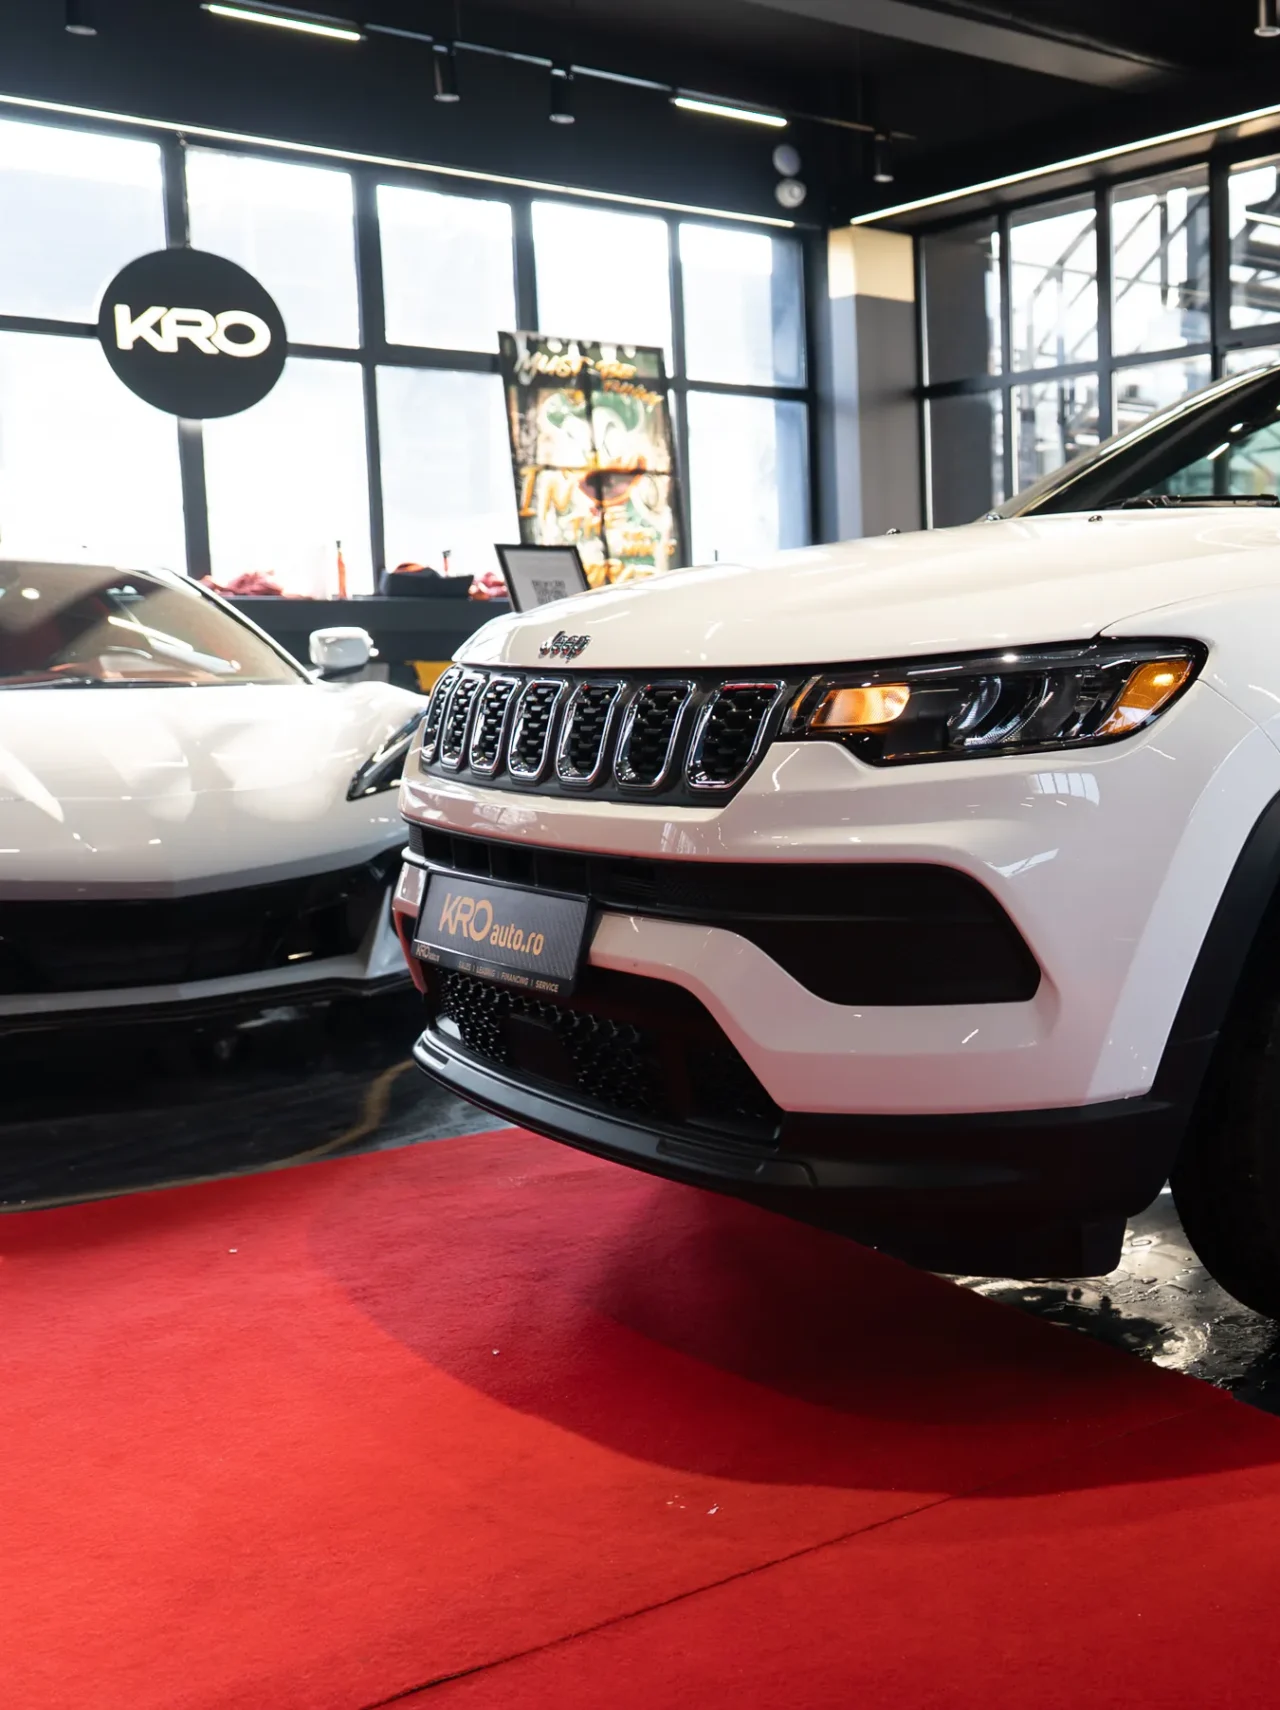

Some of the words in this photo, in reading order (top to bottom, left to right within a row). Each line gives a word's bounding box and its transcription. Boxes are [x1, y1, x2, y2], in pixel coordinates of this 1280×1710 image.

[113, 303, 272, 358] KRO
[539, 630, 591, 662] Jeep
[501, 971, 529, 986] FINANCING
[535, 980, 560, 993] SERVICE
